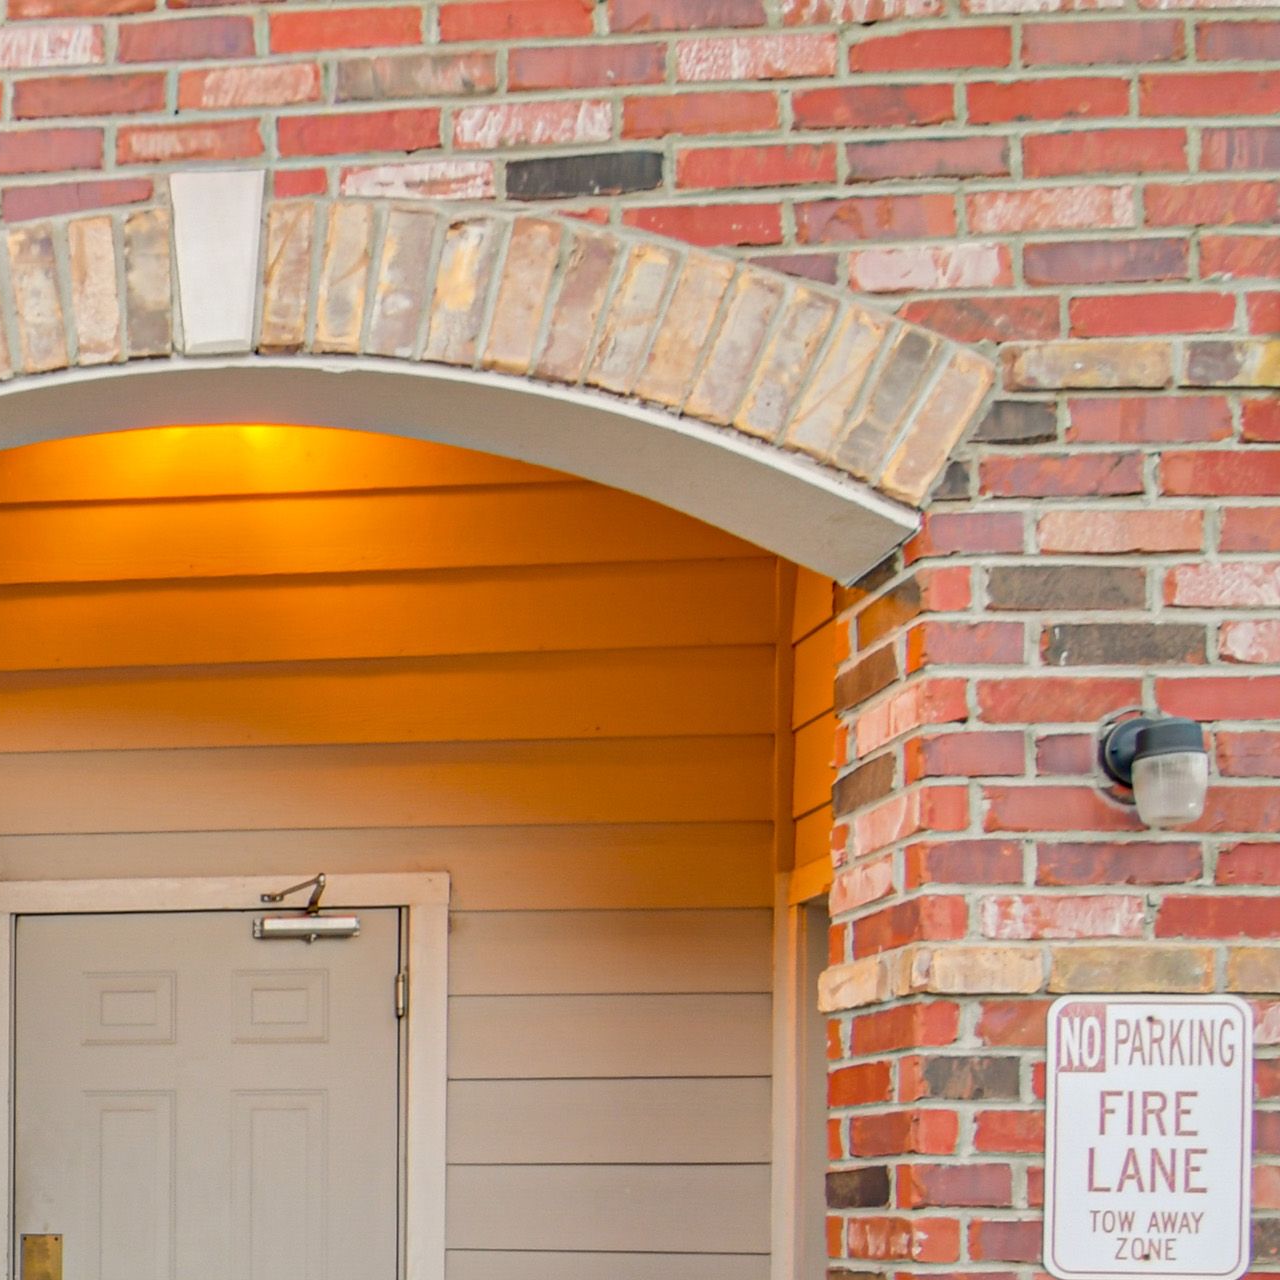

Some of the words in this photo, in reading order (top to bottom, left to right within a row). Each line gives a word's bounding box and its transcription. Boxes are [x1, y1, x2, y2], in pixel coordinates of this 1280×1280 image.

[1059, 1015, 1102, 1070] NO
[1114, 1018, 1235, 1067] PARKING
[1098, 1090, 1199, 1136] FIRE
[1087, 1147, 1208, 1194] LANE
[1090, 1210, 1136, 1233] TOW
[1146, 1211, 1205, 1234] AWAY
[1114, 1237, 1177, 1261] ZONE
